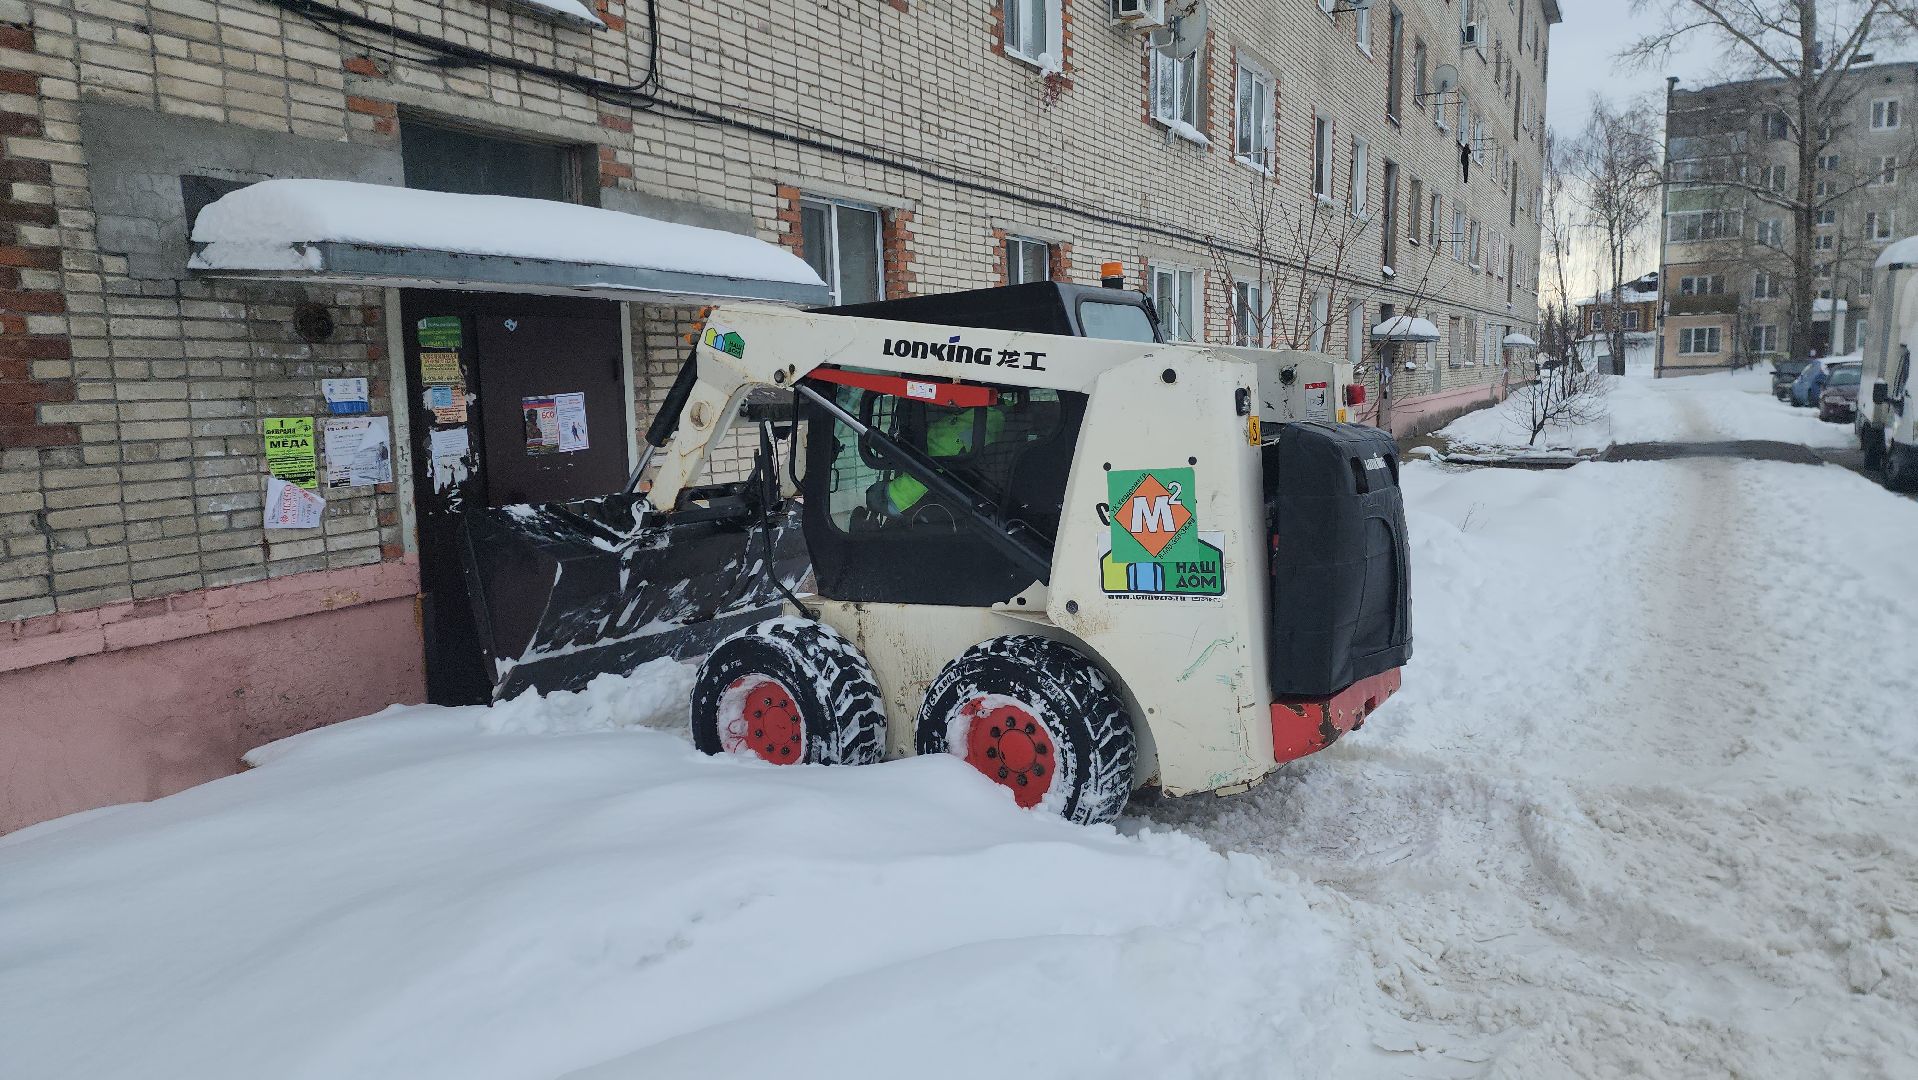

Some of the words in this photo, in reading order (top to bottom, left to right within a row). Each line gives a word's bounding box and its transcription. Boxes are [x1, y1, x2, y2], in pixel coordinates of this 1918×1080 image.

[996, 349, 1047, 371] 龙工
[270, 439, 309, 448] МЁДА
[1176, 561, 1216, 574] НАШ
[1176, 575, 1217, 588] ДОМ
